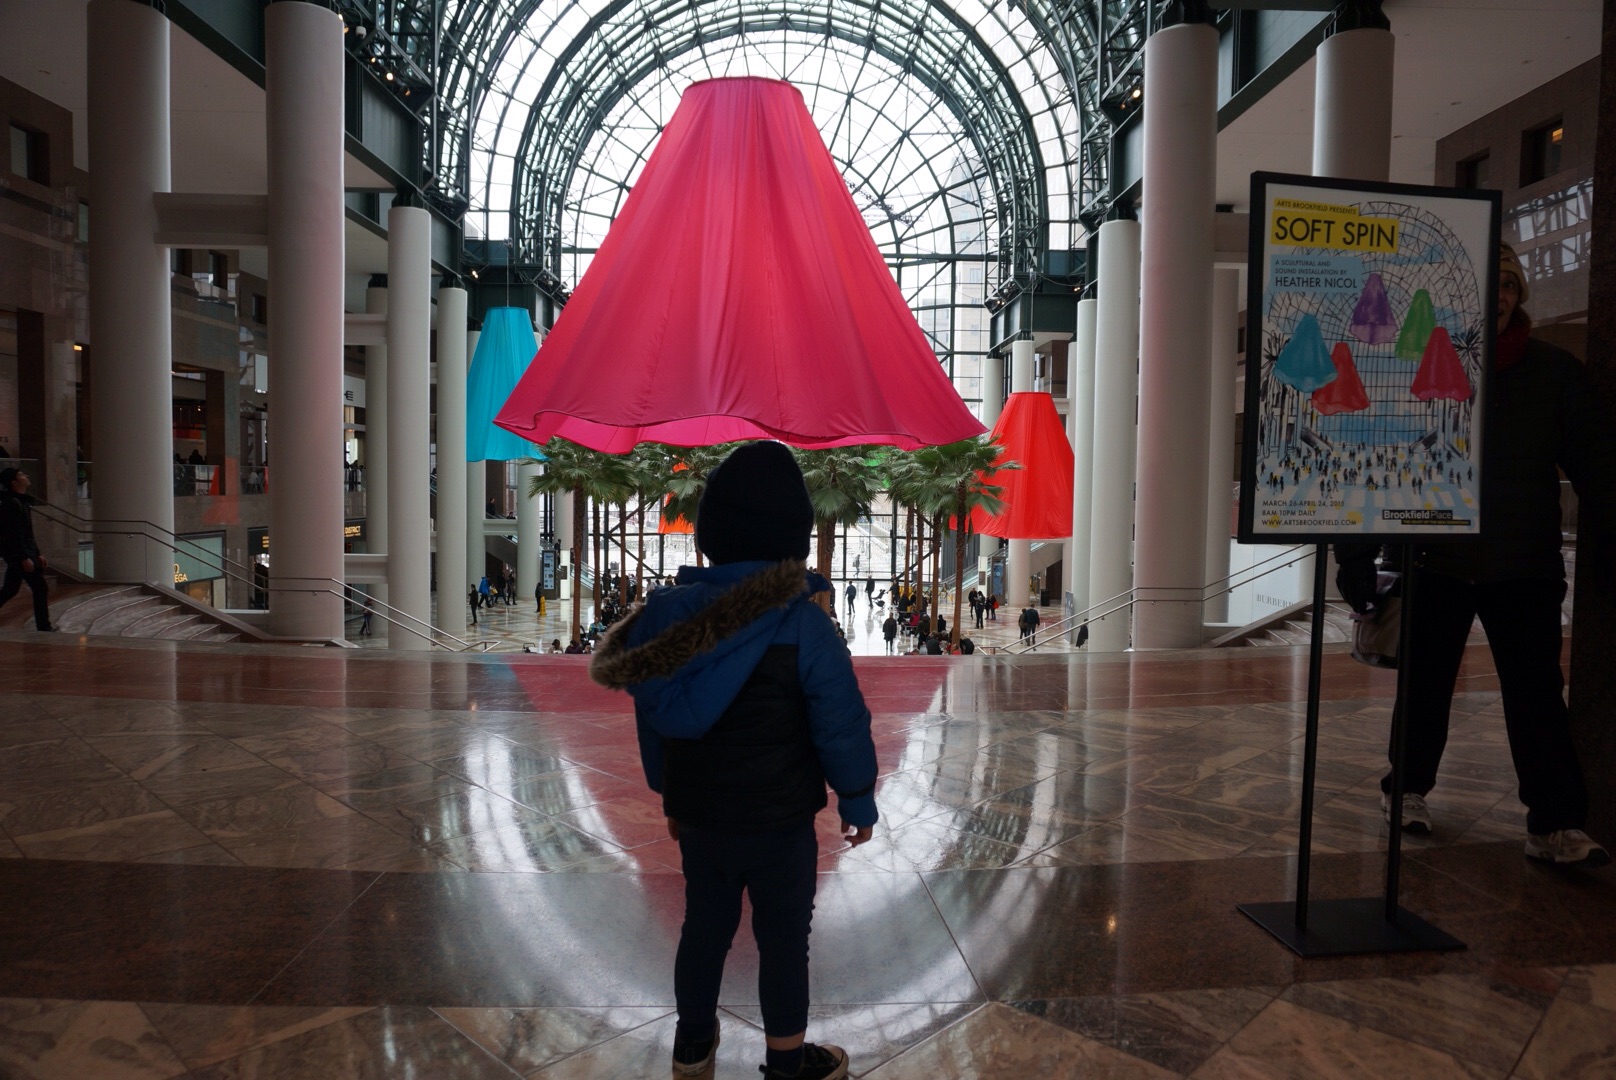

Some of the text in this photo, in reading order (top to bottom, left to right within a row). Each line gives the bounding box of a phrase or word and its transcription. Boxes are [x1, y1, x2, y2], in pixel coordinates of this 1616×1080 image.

[1292, 202, 1328, 212] BROOKFIELD
[1329, 206, 1357, 215] PRESENTS
[1275, 216, 1395, 248] SOFT SPIN
[1275, 276, 1358, 288] HEATHER NICOL
[1383, 510, 1452, 519] Brookfield Place
